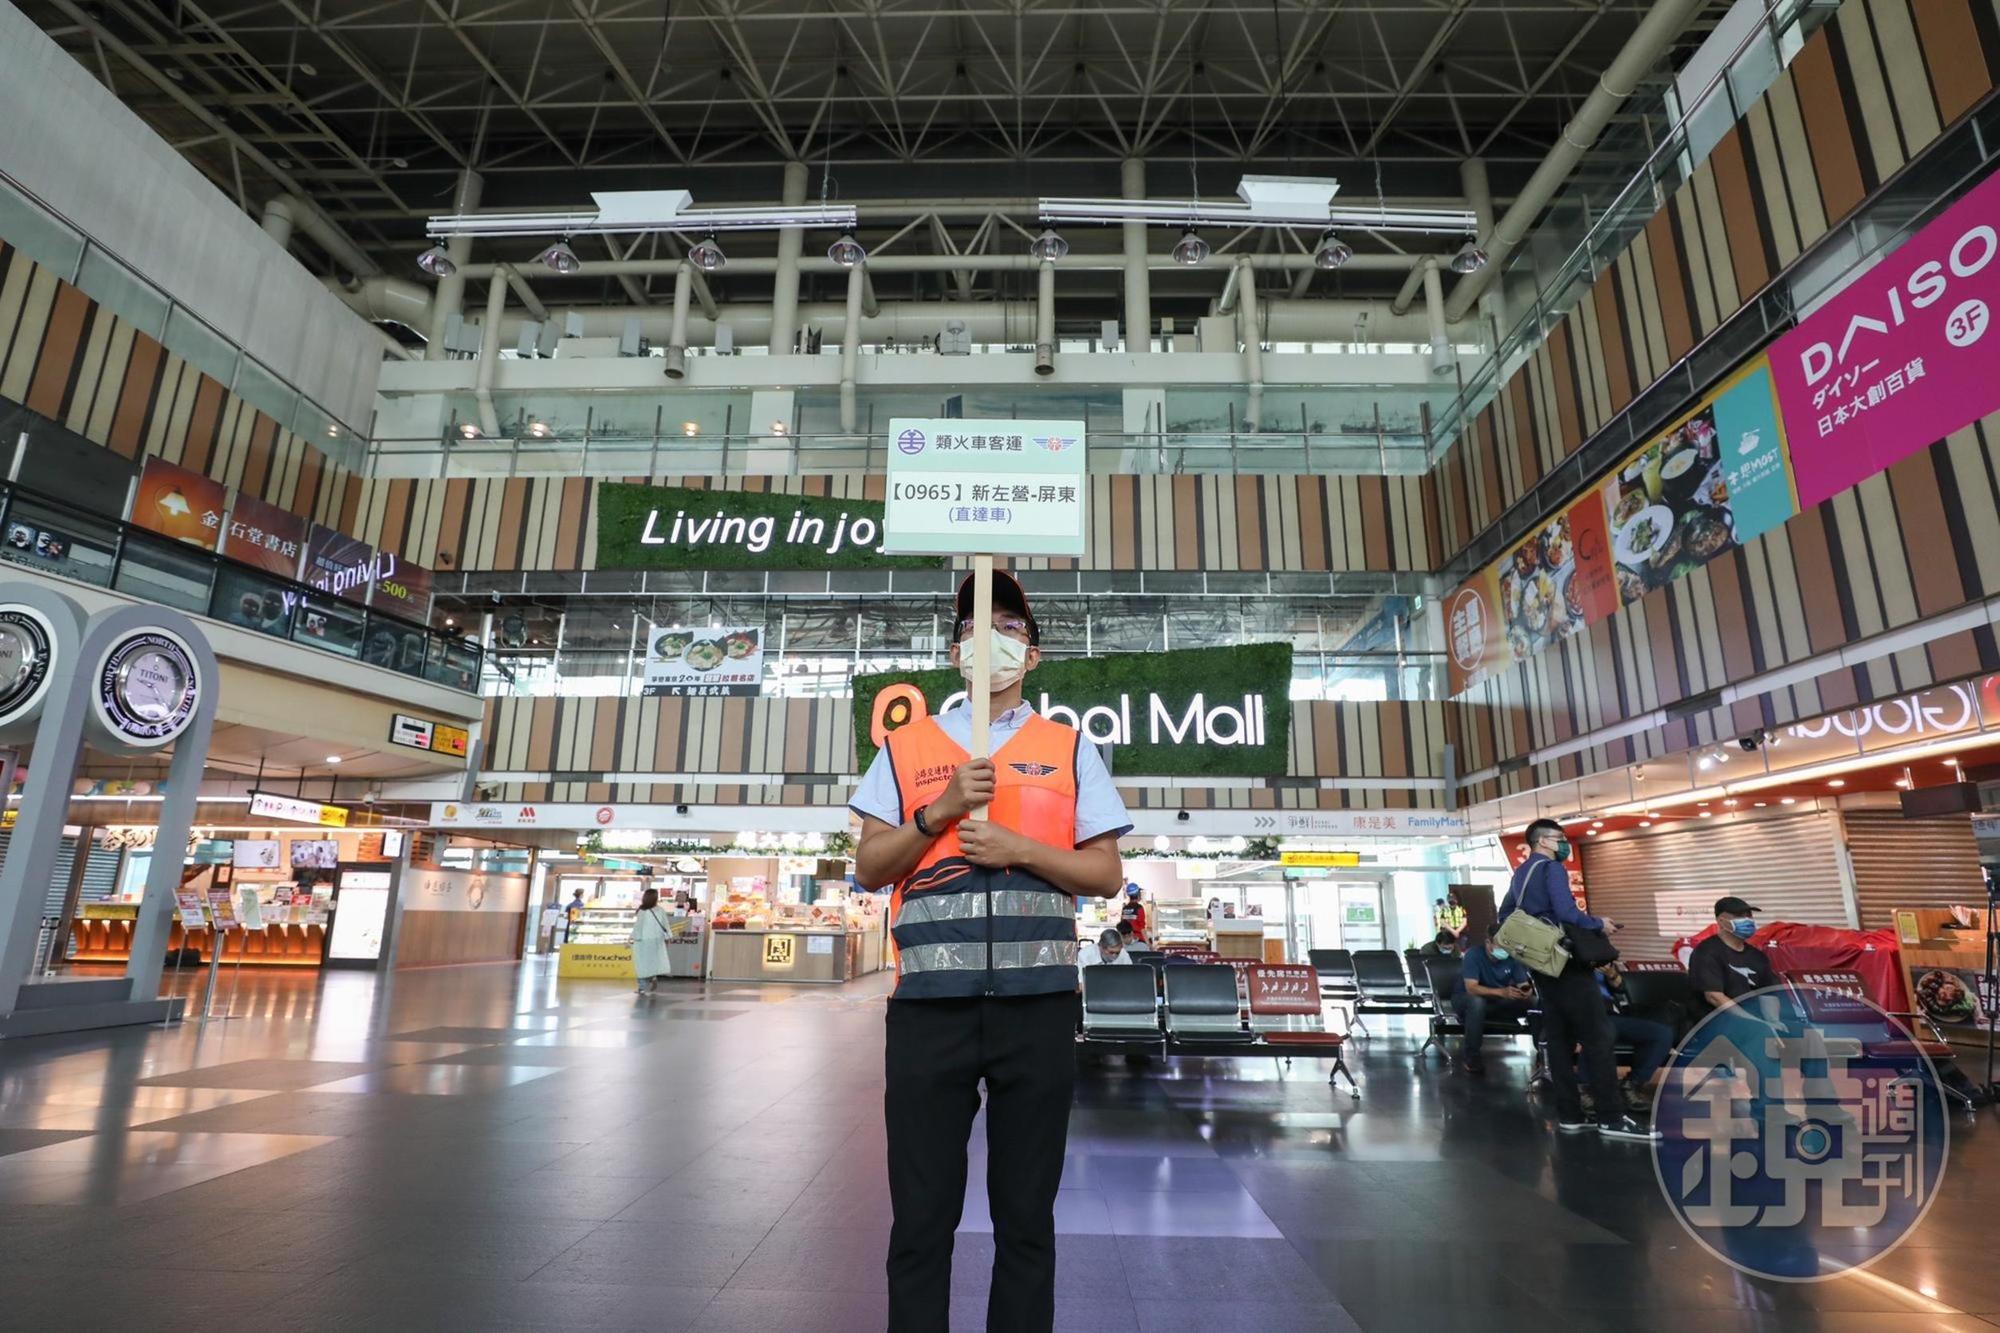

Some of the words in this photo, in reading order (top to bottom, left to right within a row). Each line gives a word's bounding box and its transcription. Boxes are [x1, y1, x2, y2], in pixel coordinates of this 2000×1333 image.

[1800, 225, 1997, 386] DAISO
[1950, 304, 1981, 340] 3F
[1812, 358, 1880, 410] ダイソー
[1817, 357, 1926, 437] 日本大創百貨
[935, 434, 1023, 451] 類火車客運
[948, 506, 1013, 523] (直達車)
[640, 510, 775, 552] Living
[786, 510, 825, 544] in
[383, 580, 407, 600] 500
[147, 635, 176, 651] NORTH
[104, 656, 119, 692] NORTH
[140, 668, 168, 683] TITONI
[643, 687, 656, 695] 3F
[938, 691, 1131, 745] bal
[1150, 692, 1265, 746] Mall
[1353, 816, 1397, 829] 康是美
[1408, 816, 1464, 829] FamilyMart
[593, 953, 632, 961] touched
